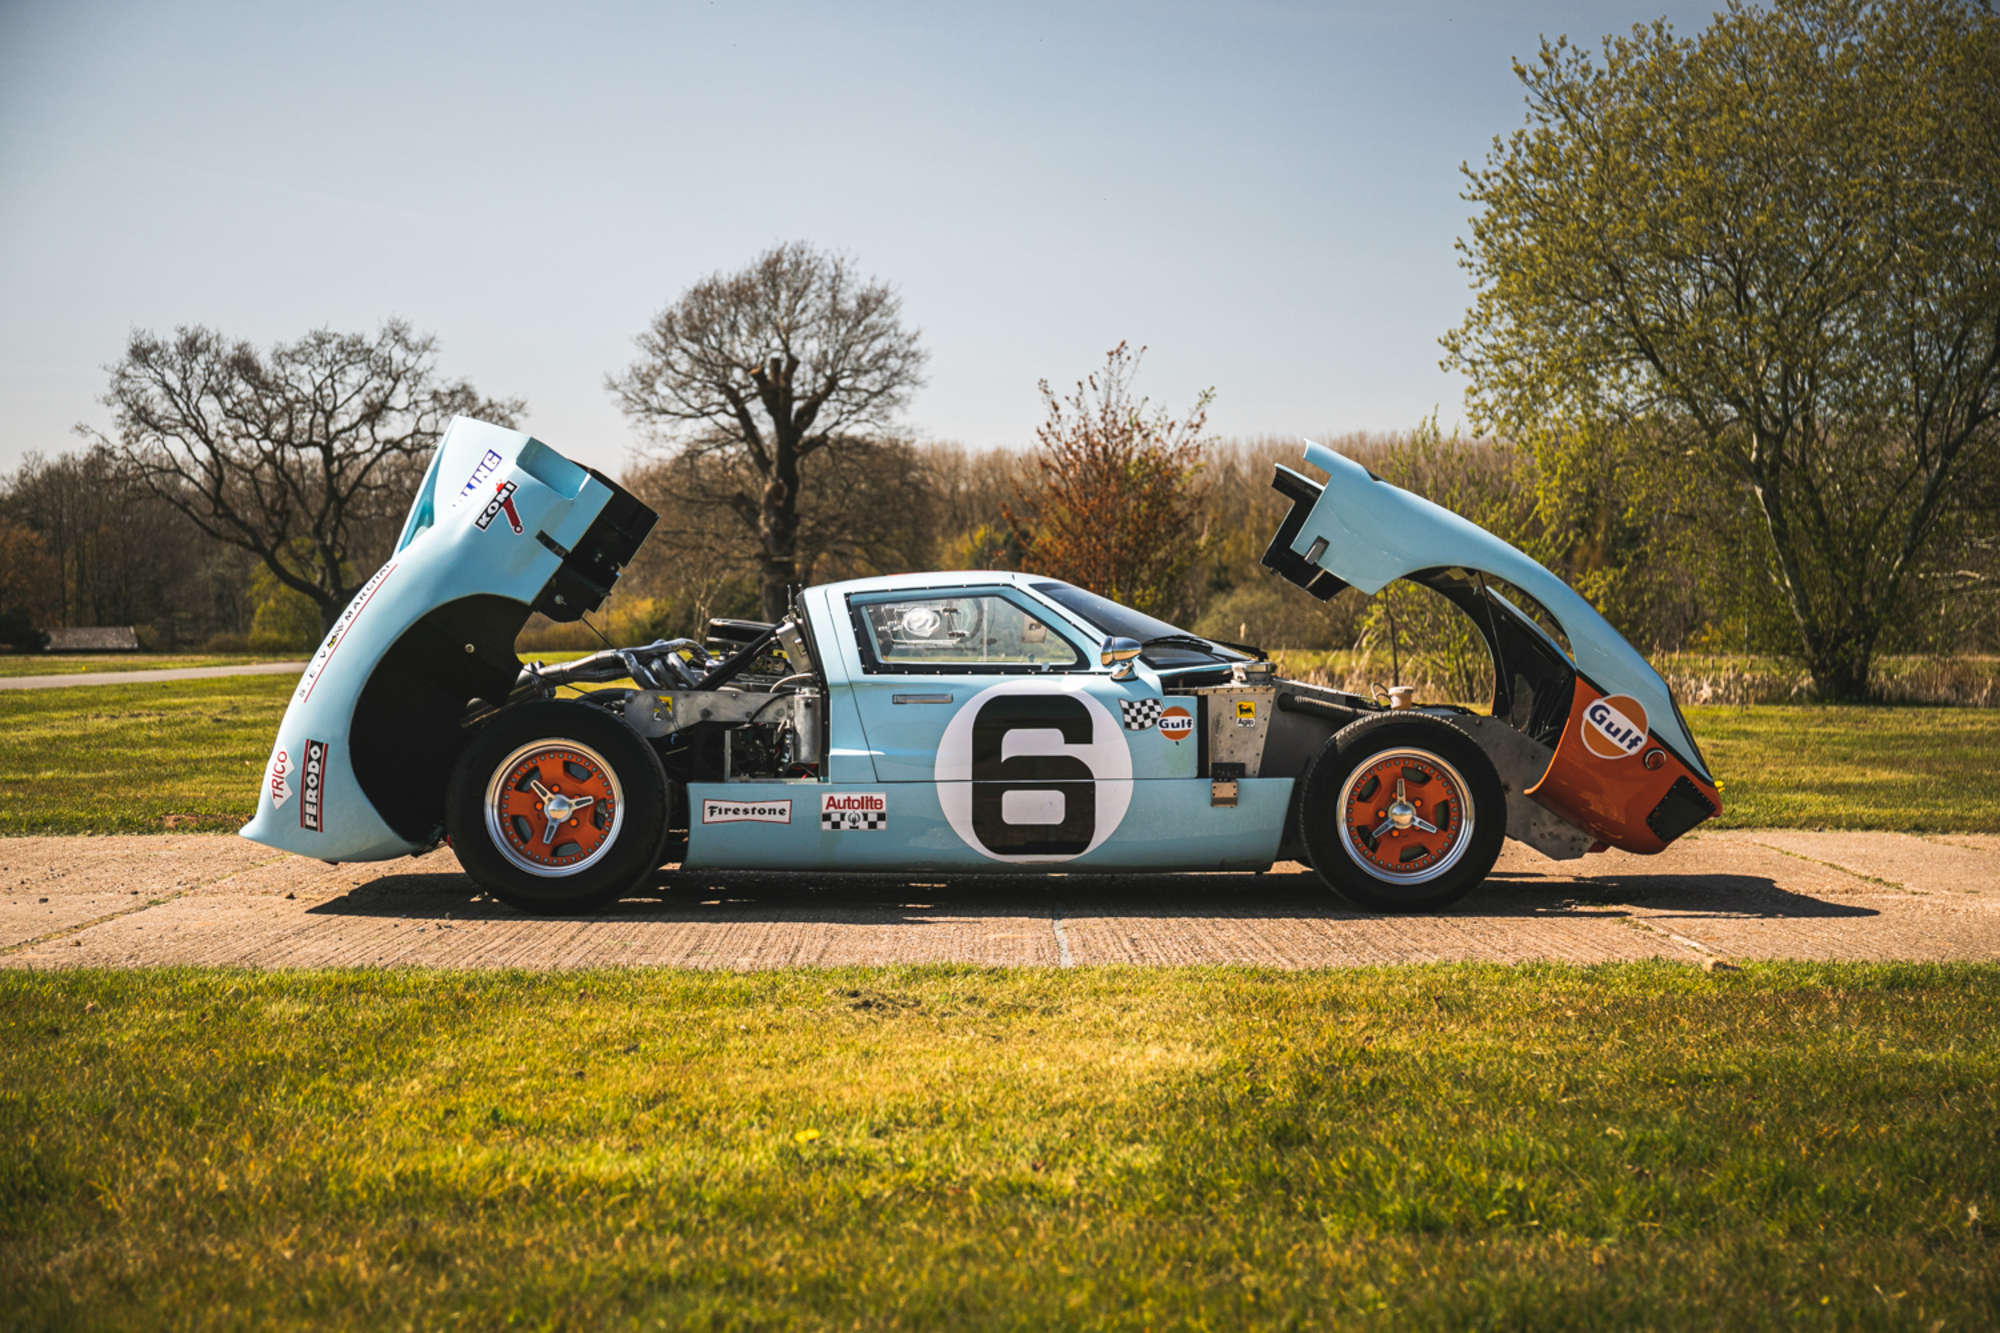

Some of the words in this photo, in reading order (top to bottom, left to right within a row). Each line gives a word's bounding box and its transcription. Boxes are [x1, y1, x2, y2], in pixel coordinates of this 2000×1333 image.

[477, 482, 516, 527] KONI
[1158, 718, 1192, 729] Gulf
[1589, 704, 1643, 750] Gulf
[271, 751, 288, 800] TRICO
[305, 745, 321, 828] FERODO
[972, 694, 1096, 855] 6
[707, 804, 787, 818] Firestone
[825, 795, 884, 811] Autolite
